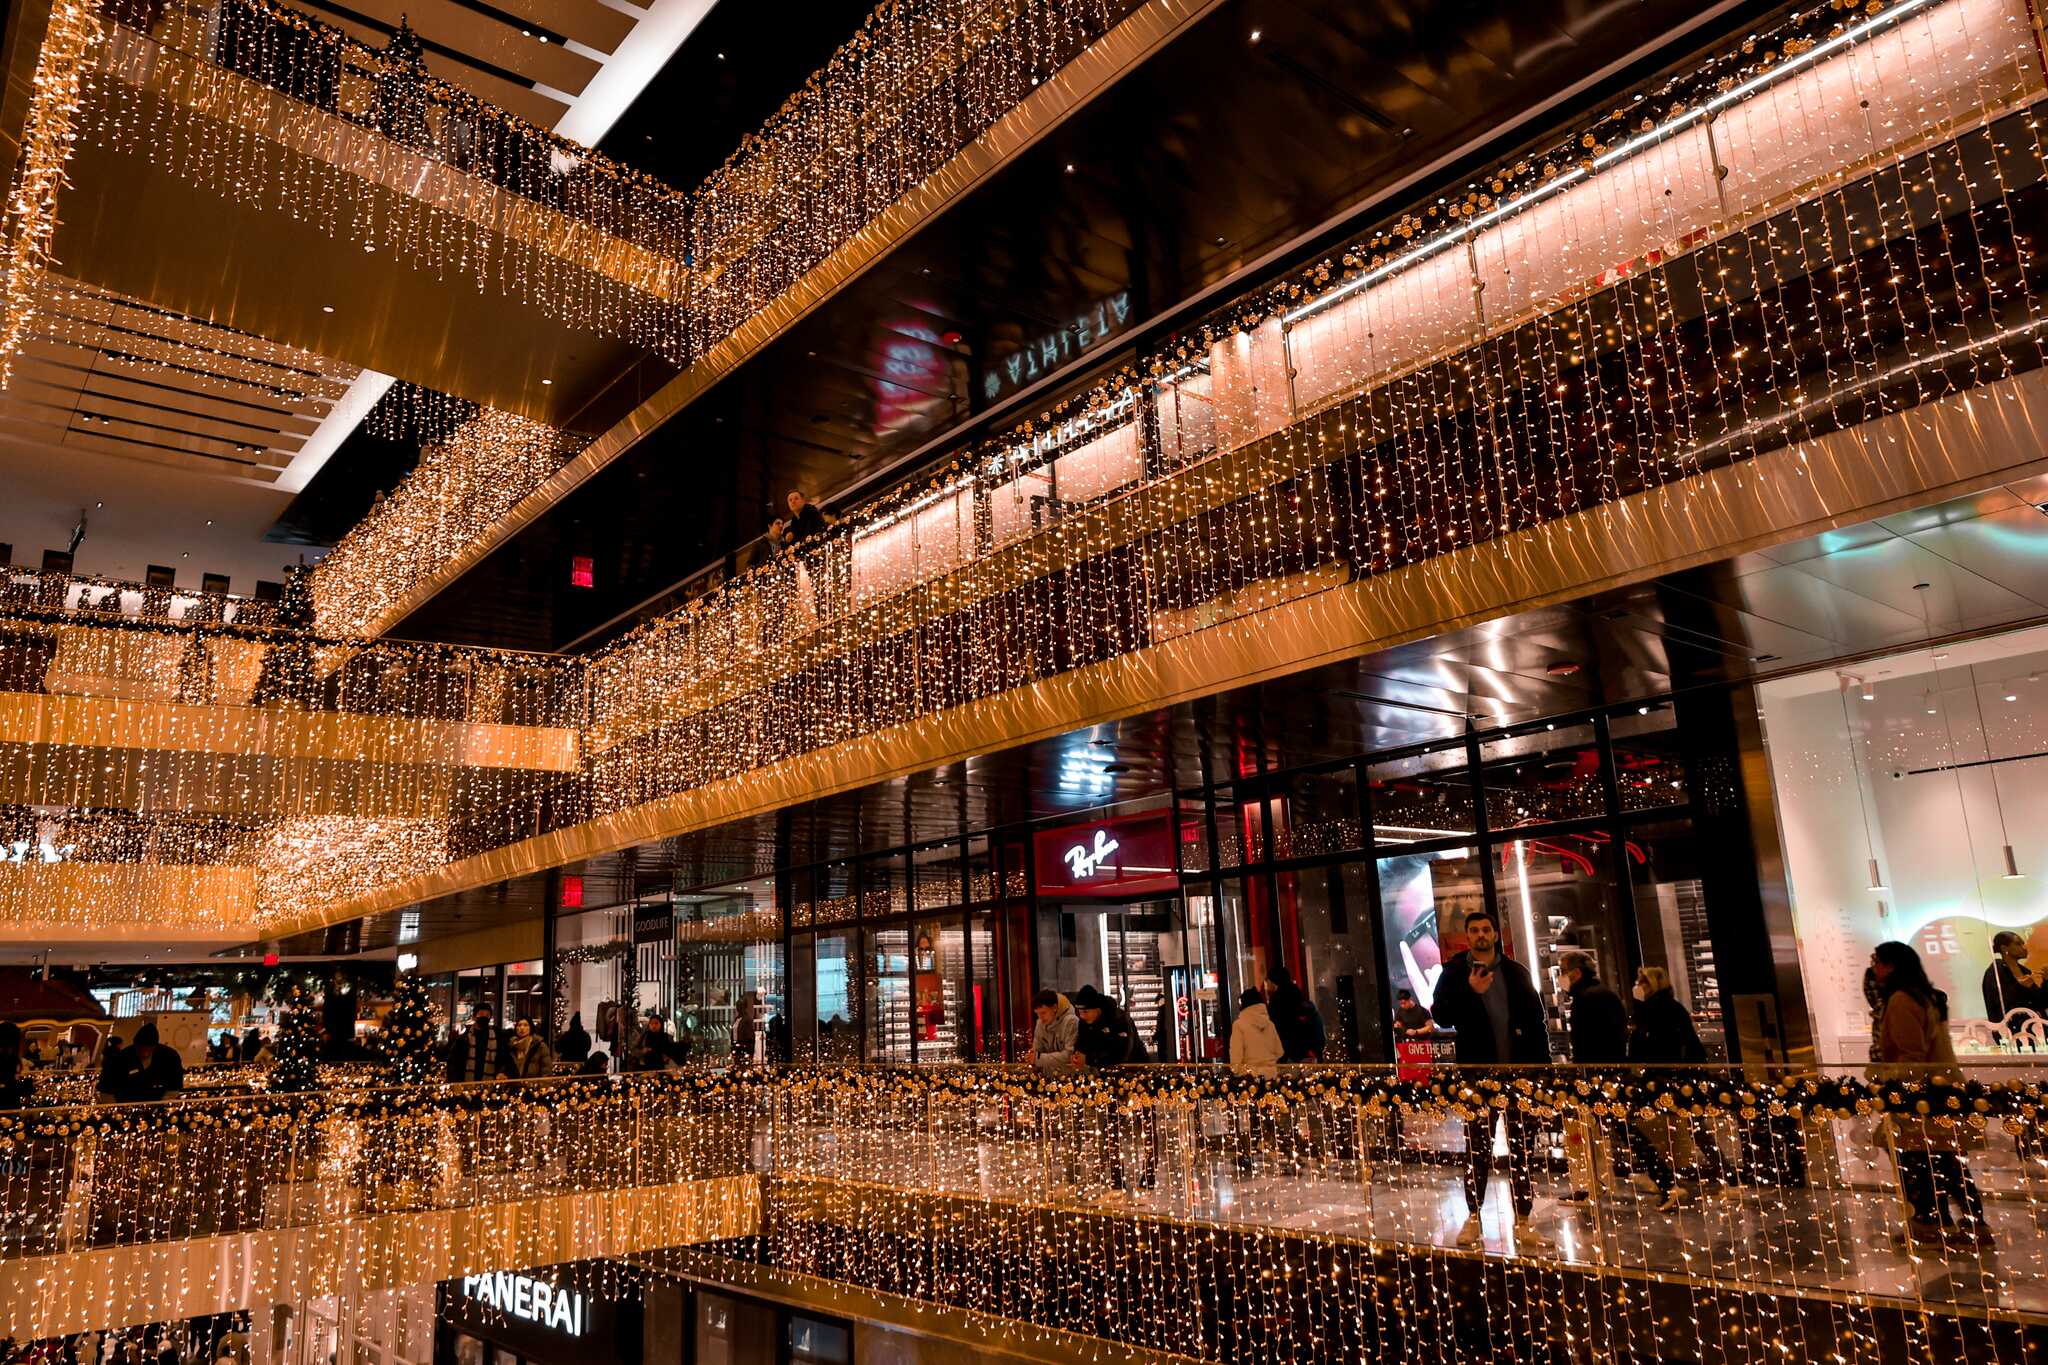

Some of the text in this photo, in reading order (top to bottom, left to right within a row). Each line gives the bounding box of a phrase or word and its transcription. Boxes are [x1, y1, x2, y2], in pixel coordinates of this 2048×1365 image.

[635, 916, 669, 932] GOODLIFE
[1408, 1043, 1424, 1055] GIVE
[1425, 1043, 1439, 1055] THE
[464, 1271, 581, 1336] PANERAI
